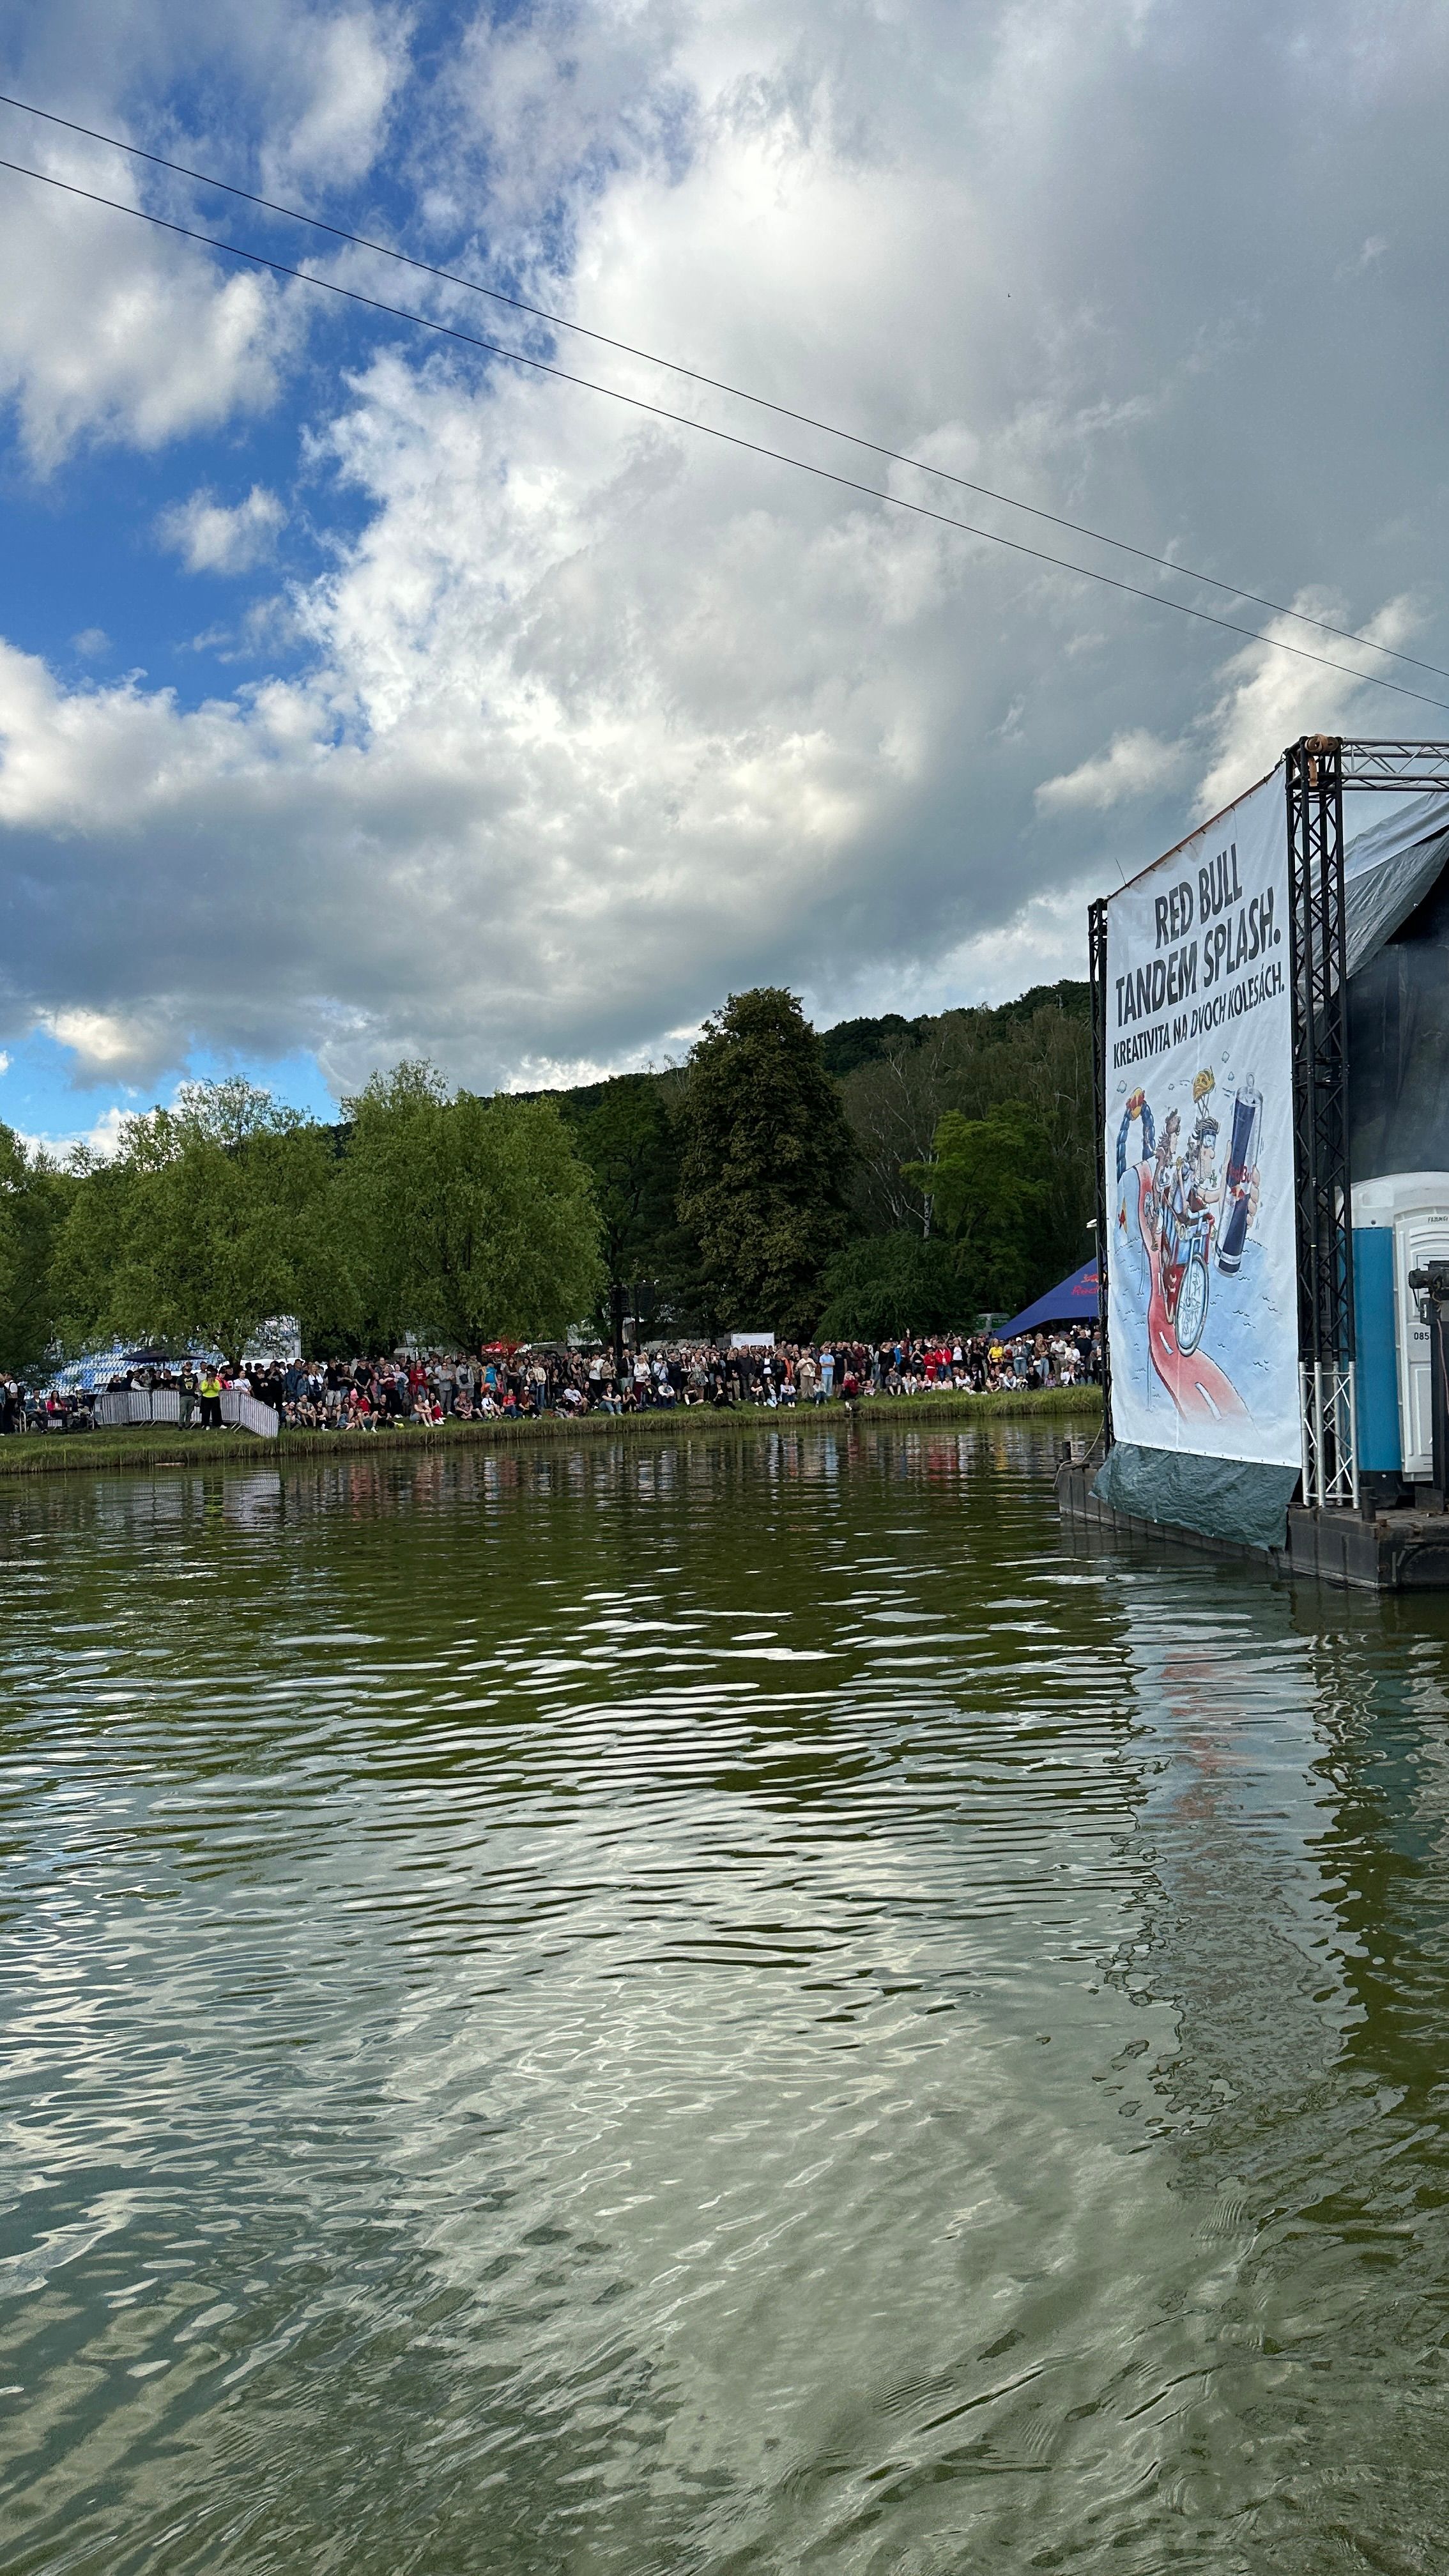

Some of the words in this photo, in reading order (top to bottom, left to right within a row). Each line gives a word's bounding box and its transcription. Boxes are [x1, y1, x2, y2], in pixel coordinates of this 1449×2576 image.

[1155, 882, 1193, 949] RED
[1199, 843, 1242, 924] BULL
[1116, 940, 1197, 1027] TANDEM
[1204, 886, 1281, 988] SPLASH.
[1114, 1023, 1170, 1069] KREATIVITA
[1174, 1014, 1187, 1046] NA
[1190, 993, 1227, 1038] DVOCH
[1228, 962, 1285, 1020] KOLESÁCH.
